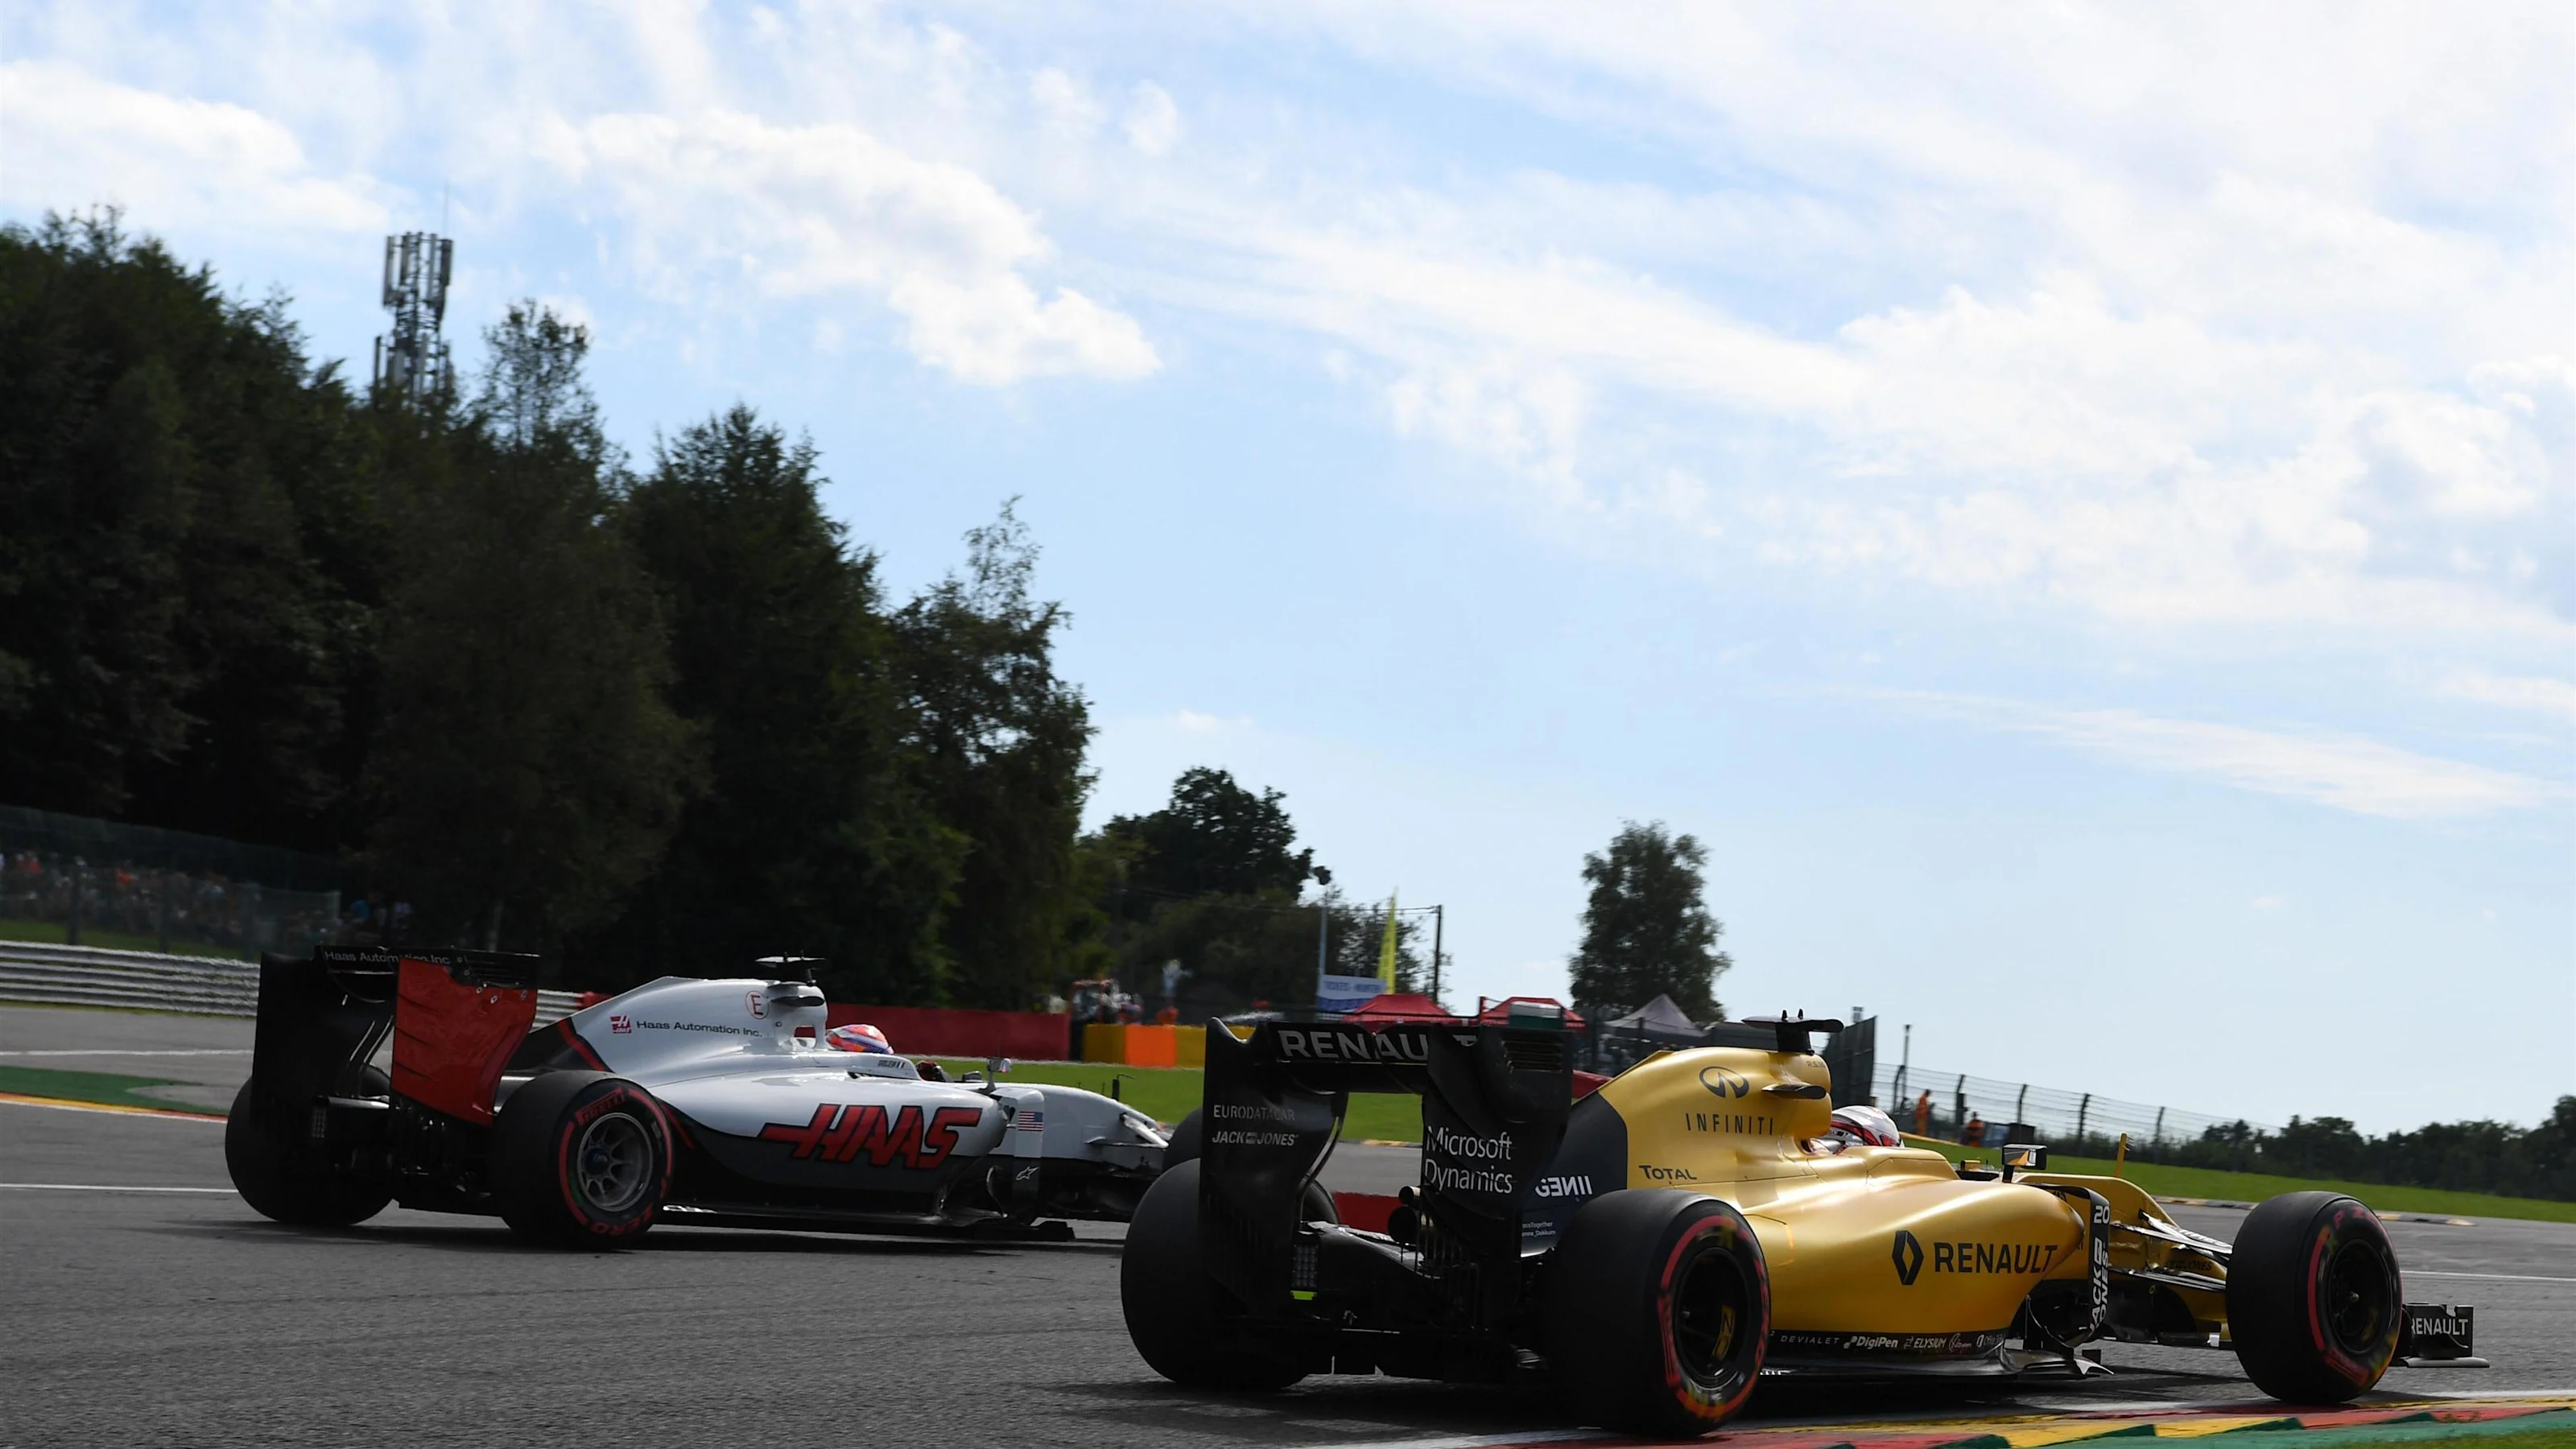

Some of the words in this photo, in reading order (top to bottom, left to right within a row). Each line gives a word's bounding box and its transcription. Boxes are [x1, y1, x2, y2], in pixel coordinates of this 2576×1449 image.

[324, 951, 357, 963] Haas
[751, 995, 764, 1015] E
[637, 1020, 671, 1030] Haas
[674, 1022, 741, 1035] Automation
[743, 1027, 763, 1038] Inc.
[1213, 1104, 1295, 1121] EURODATACAR
[1685, 1113, 1773, 1135] INFINITI
[757, 1103, 983, 1170] HAAS
[1212, 1130, 1245, 1144] JACK
[1426, 1125, 1513, 1160] Microsoft
[1424, 1158, 1513, 1195] Dynamics
[2094, 1205, 2110, 1224] 20
[1934, 1241, 2058, 1274] RENAULT
[1780, 1335, 1840, 1345] DEVIALET
[1856, 1335, 1899, 1350] DigiPen
[1913, 1337, 1947, 1349] ELYSIUM
